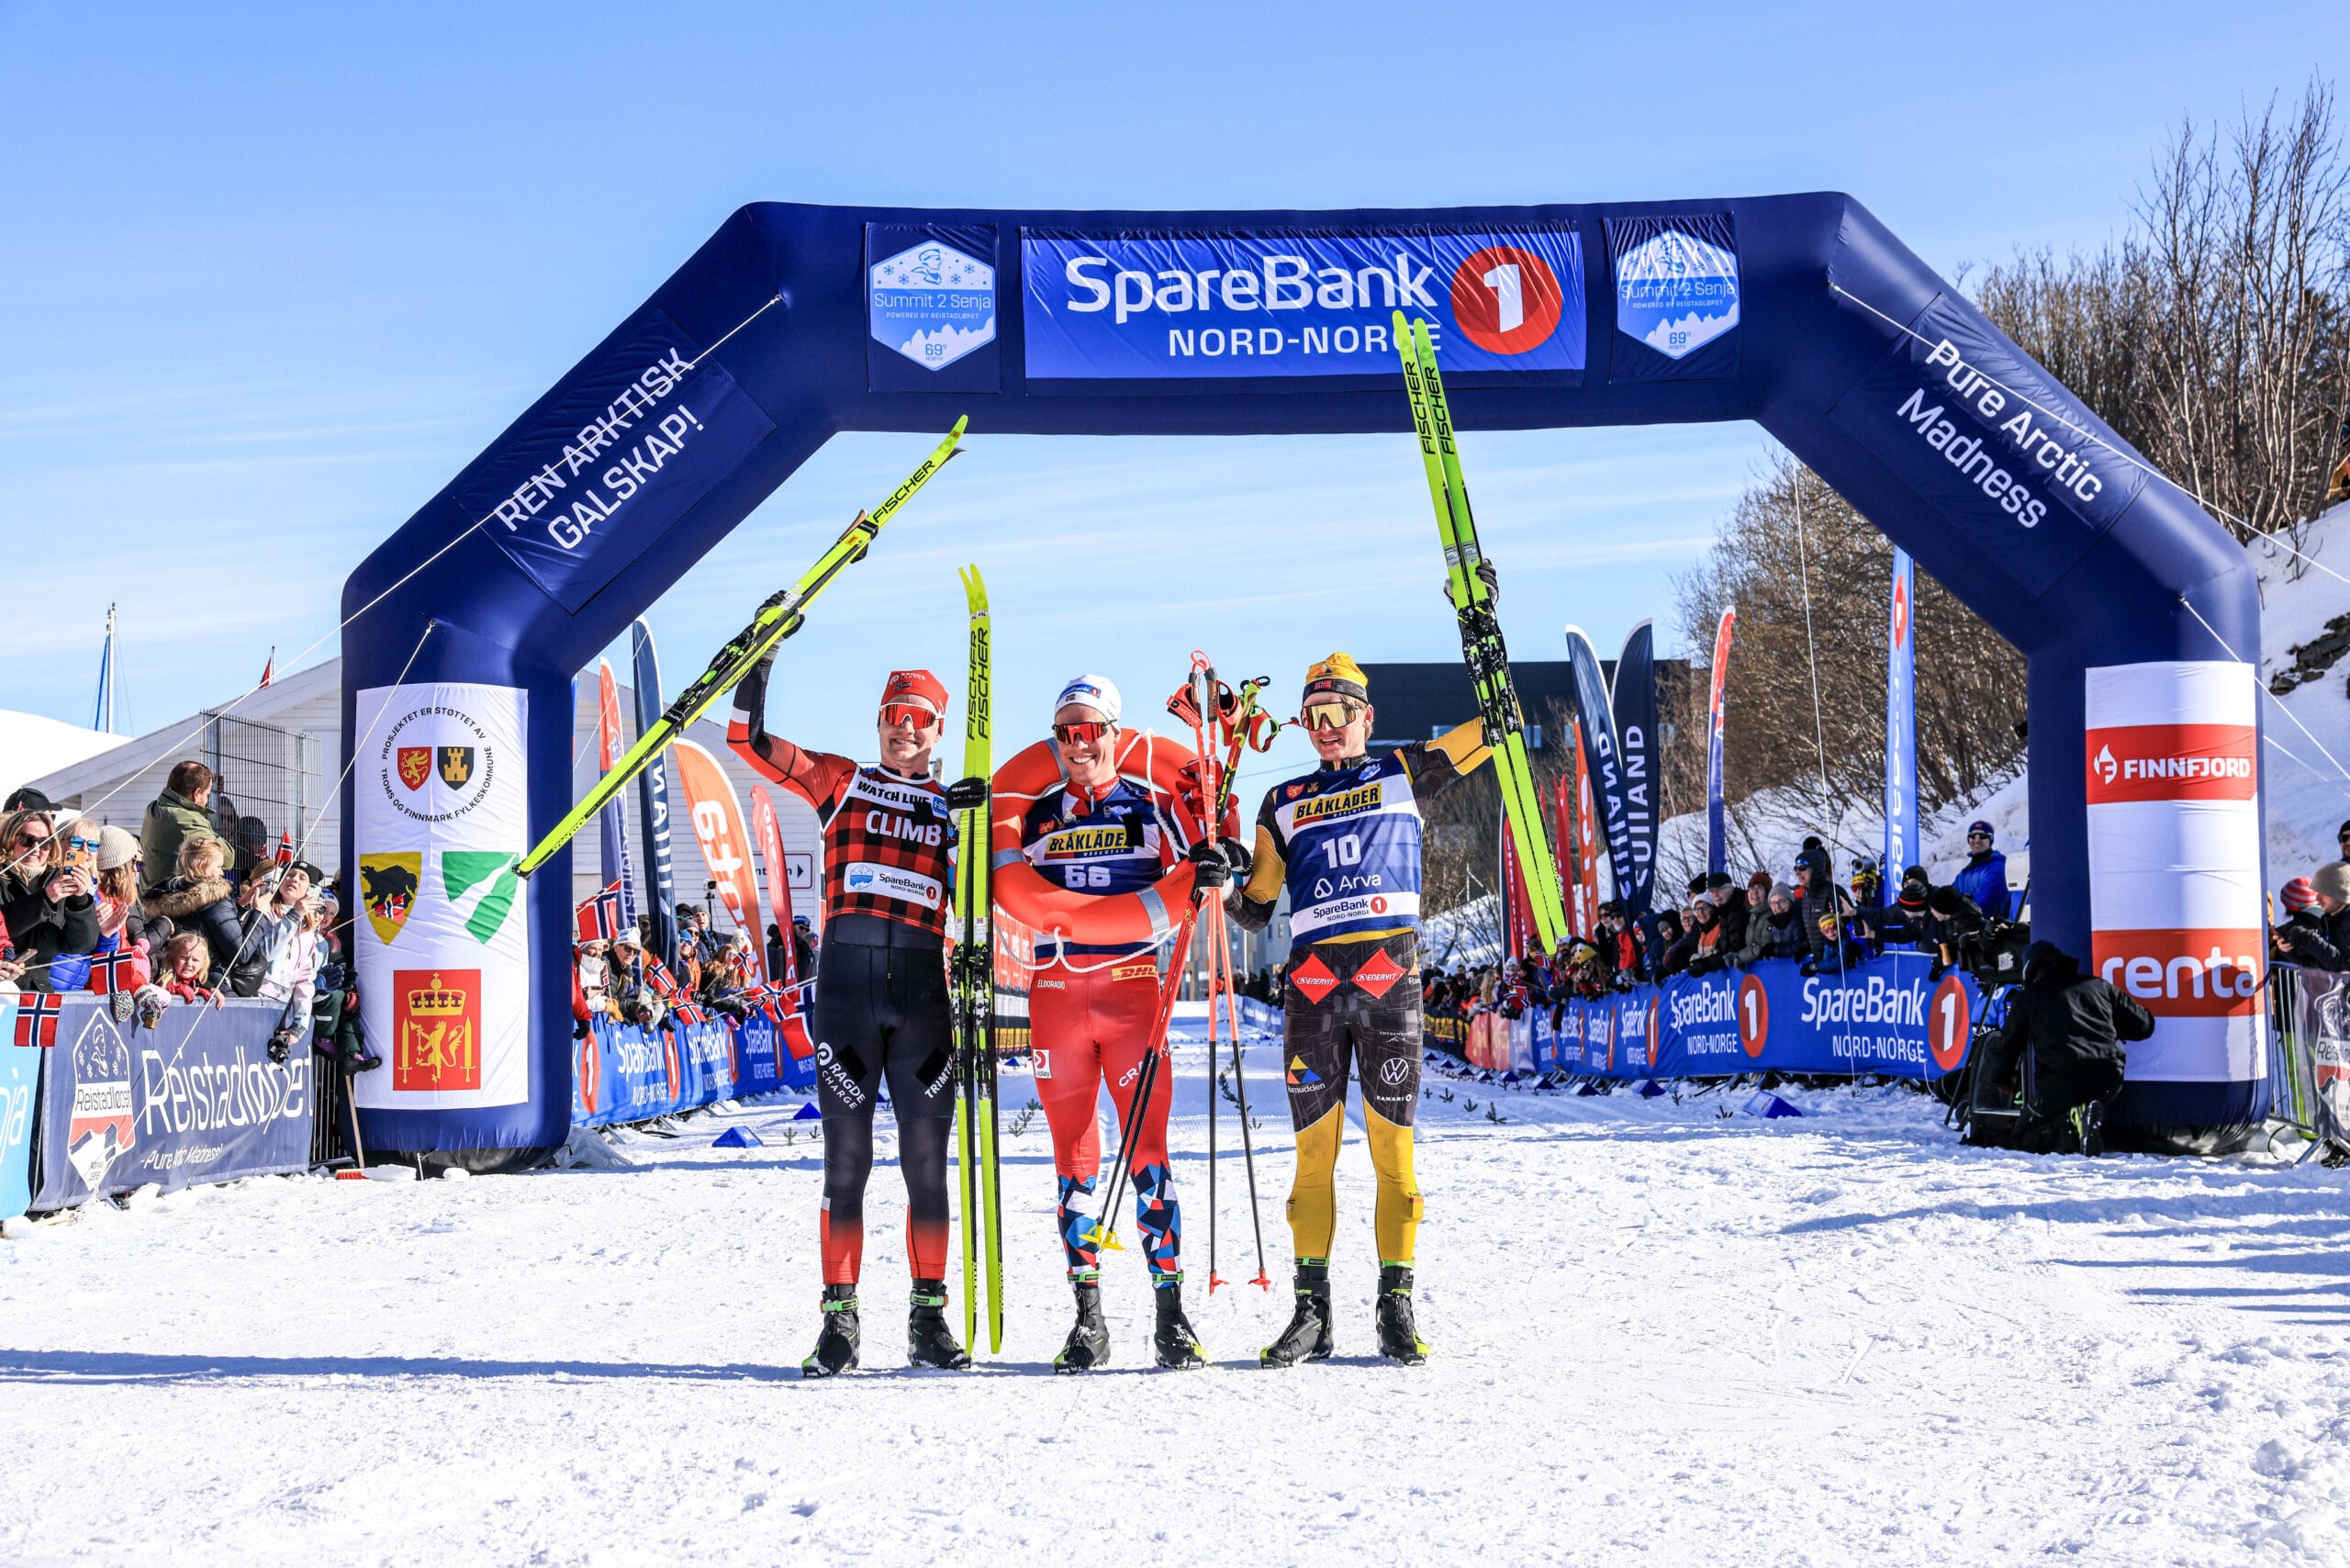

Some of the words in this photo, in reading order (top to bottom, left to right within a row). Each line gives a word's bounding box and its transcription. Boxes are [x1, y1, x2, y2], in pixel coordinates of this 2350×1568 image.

[874, 293, 934, 308] Summit
[937, 294, 947, 308] 2
[950, 294, 991, 311] Senja
[1066, 252, 1438, 324] SpareBank
[1483, 263, 1524, 333] 1
[1621, 283, 1678, 299] Summit
[1682, 283, 1692, 297] 2
[1695, 281, 1736, 297] Senja
[1404, 361, 1437, 454] FISCHER
[1425, 366, 1455, 455] FISCHER
[1925, 339, 2006, 419] Pure
[1999, 411, 2102, 502] Arctic
[494, 464, 567, 532] REN
[562, 347, 695, 477] ARKTISK
[1897, 387, 2047, 529] Madness
[547, 404, 704, 550] GALSKAP!
[872, 460, 935, 523] FISCHER
[978, 627, 989, 740] FISCHER
[382, 711, 418, 760] PROSJEKTET
[420, 708, 432, 716] ER
[435, 706, 476, 727] STØTTET
[474, 728, 487, 740] AV
[381, 767, 395, 800] TROMS
[393, 799, 404, 811] OG
[404, 808, 453, 823] FINNMARK
[454, 746, 494, 818] FYLKESKOMMUNE
[2124, 757, 2251, 779] FINNFJORD
[856, 781, 900, 802] WATCH
[1295, 787, 1379, 820] BLÅKLÄDER
[866, 810, 942, 846] CLIMB
[1048, 829, 1131, 852] BLÅKLÄDE
[1322, 834, 1361, 868] 10
[878, 873, 926, 891] SpareBank
[1338, 874, 1382, 891] Arva
[1313, 899, 1369, 919] SpareBank
[1375, 899, 1382, 911] 1
[1326, 909, 1370, 922] NORD-NORGE
[1037, 979, 1066, 989] ELDORADO
[1307, 978, 1335, 986] ENERVIT
[1366, 973, 1396, 982] ENERVIT
[2101, 946, 2257, 999] renta
[1670, 978, 1737, 1035] SpareBank
[1745, 990, 1757, 1042] 1
[1801, 977, 1926, 1031] SpareBank
[1942, 992, 1956, 1052] 1
[1687, 1033, 1738, 1056] NORD-NORGE
[1833, 1035, 1927, 1063] NORD-NORGE
[141, 1046, 314, 1135] Reistadløpet
[822, 1070, 857, 1110] CHARGE
[829, 1062, 866, 1104] RAGDE
